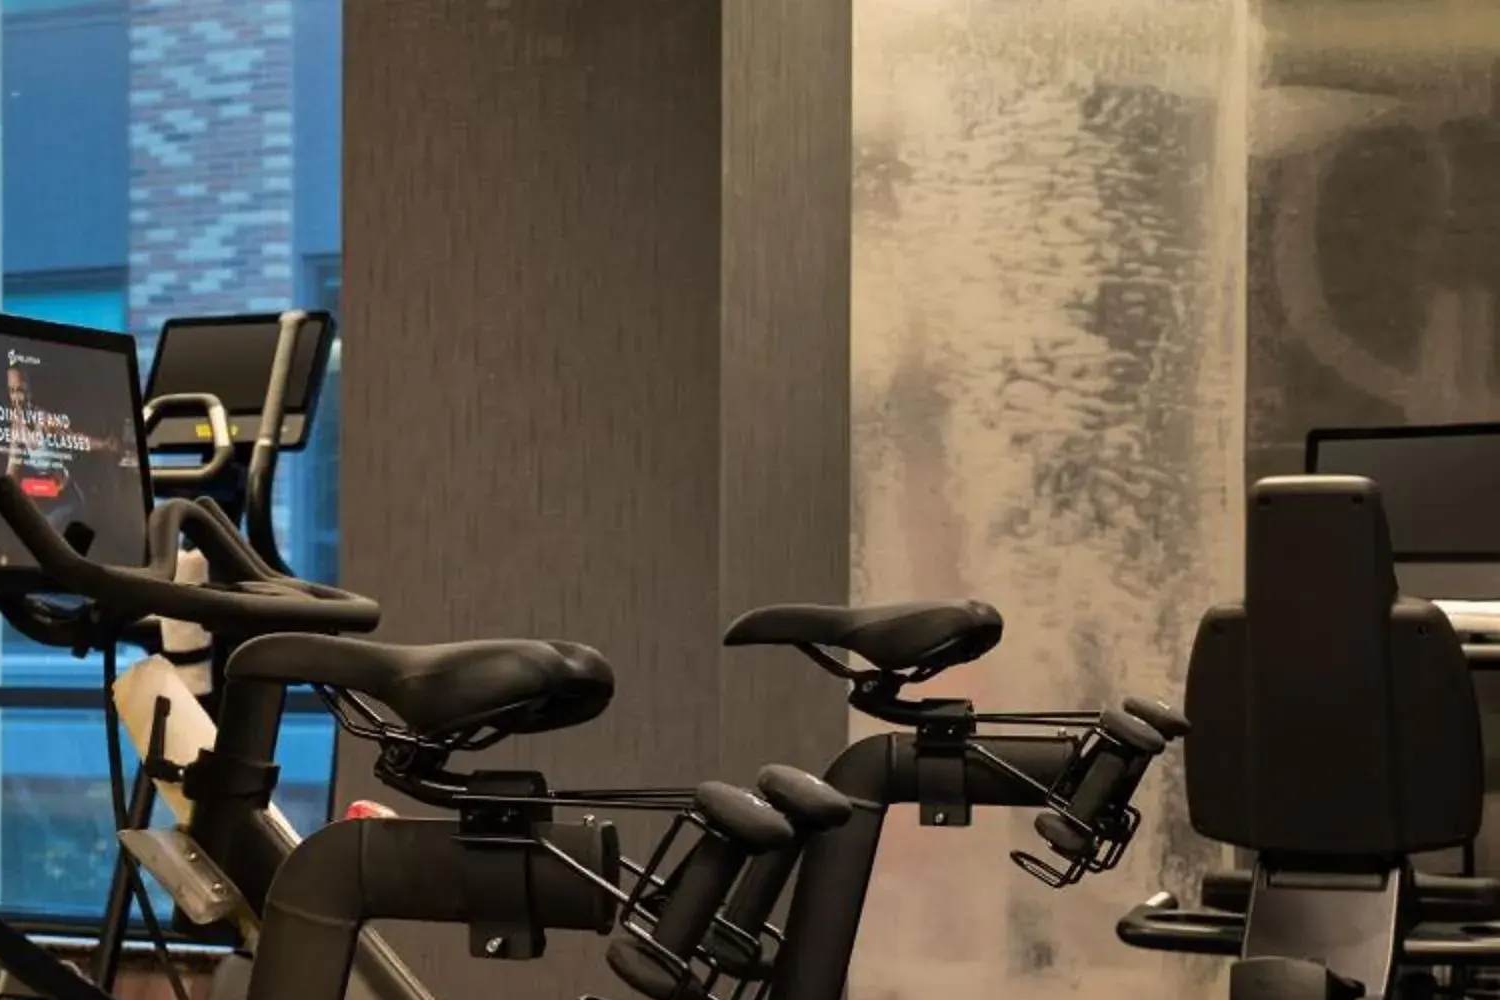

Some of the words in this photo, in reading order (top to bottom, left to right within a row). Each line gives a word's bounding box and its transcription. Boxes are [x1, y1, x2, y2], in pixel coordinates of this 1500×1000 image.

[22, 409, 45, 426] LIVE
[47, 413, 71, 429] AND
[48, 433, 91, 452] CLASSES
